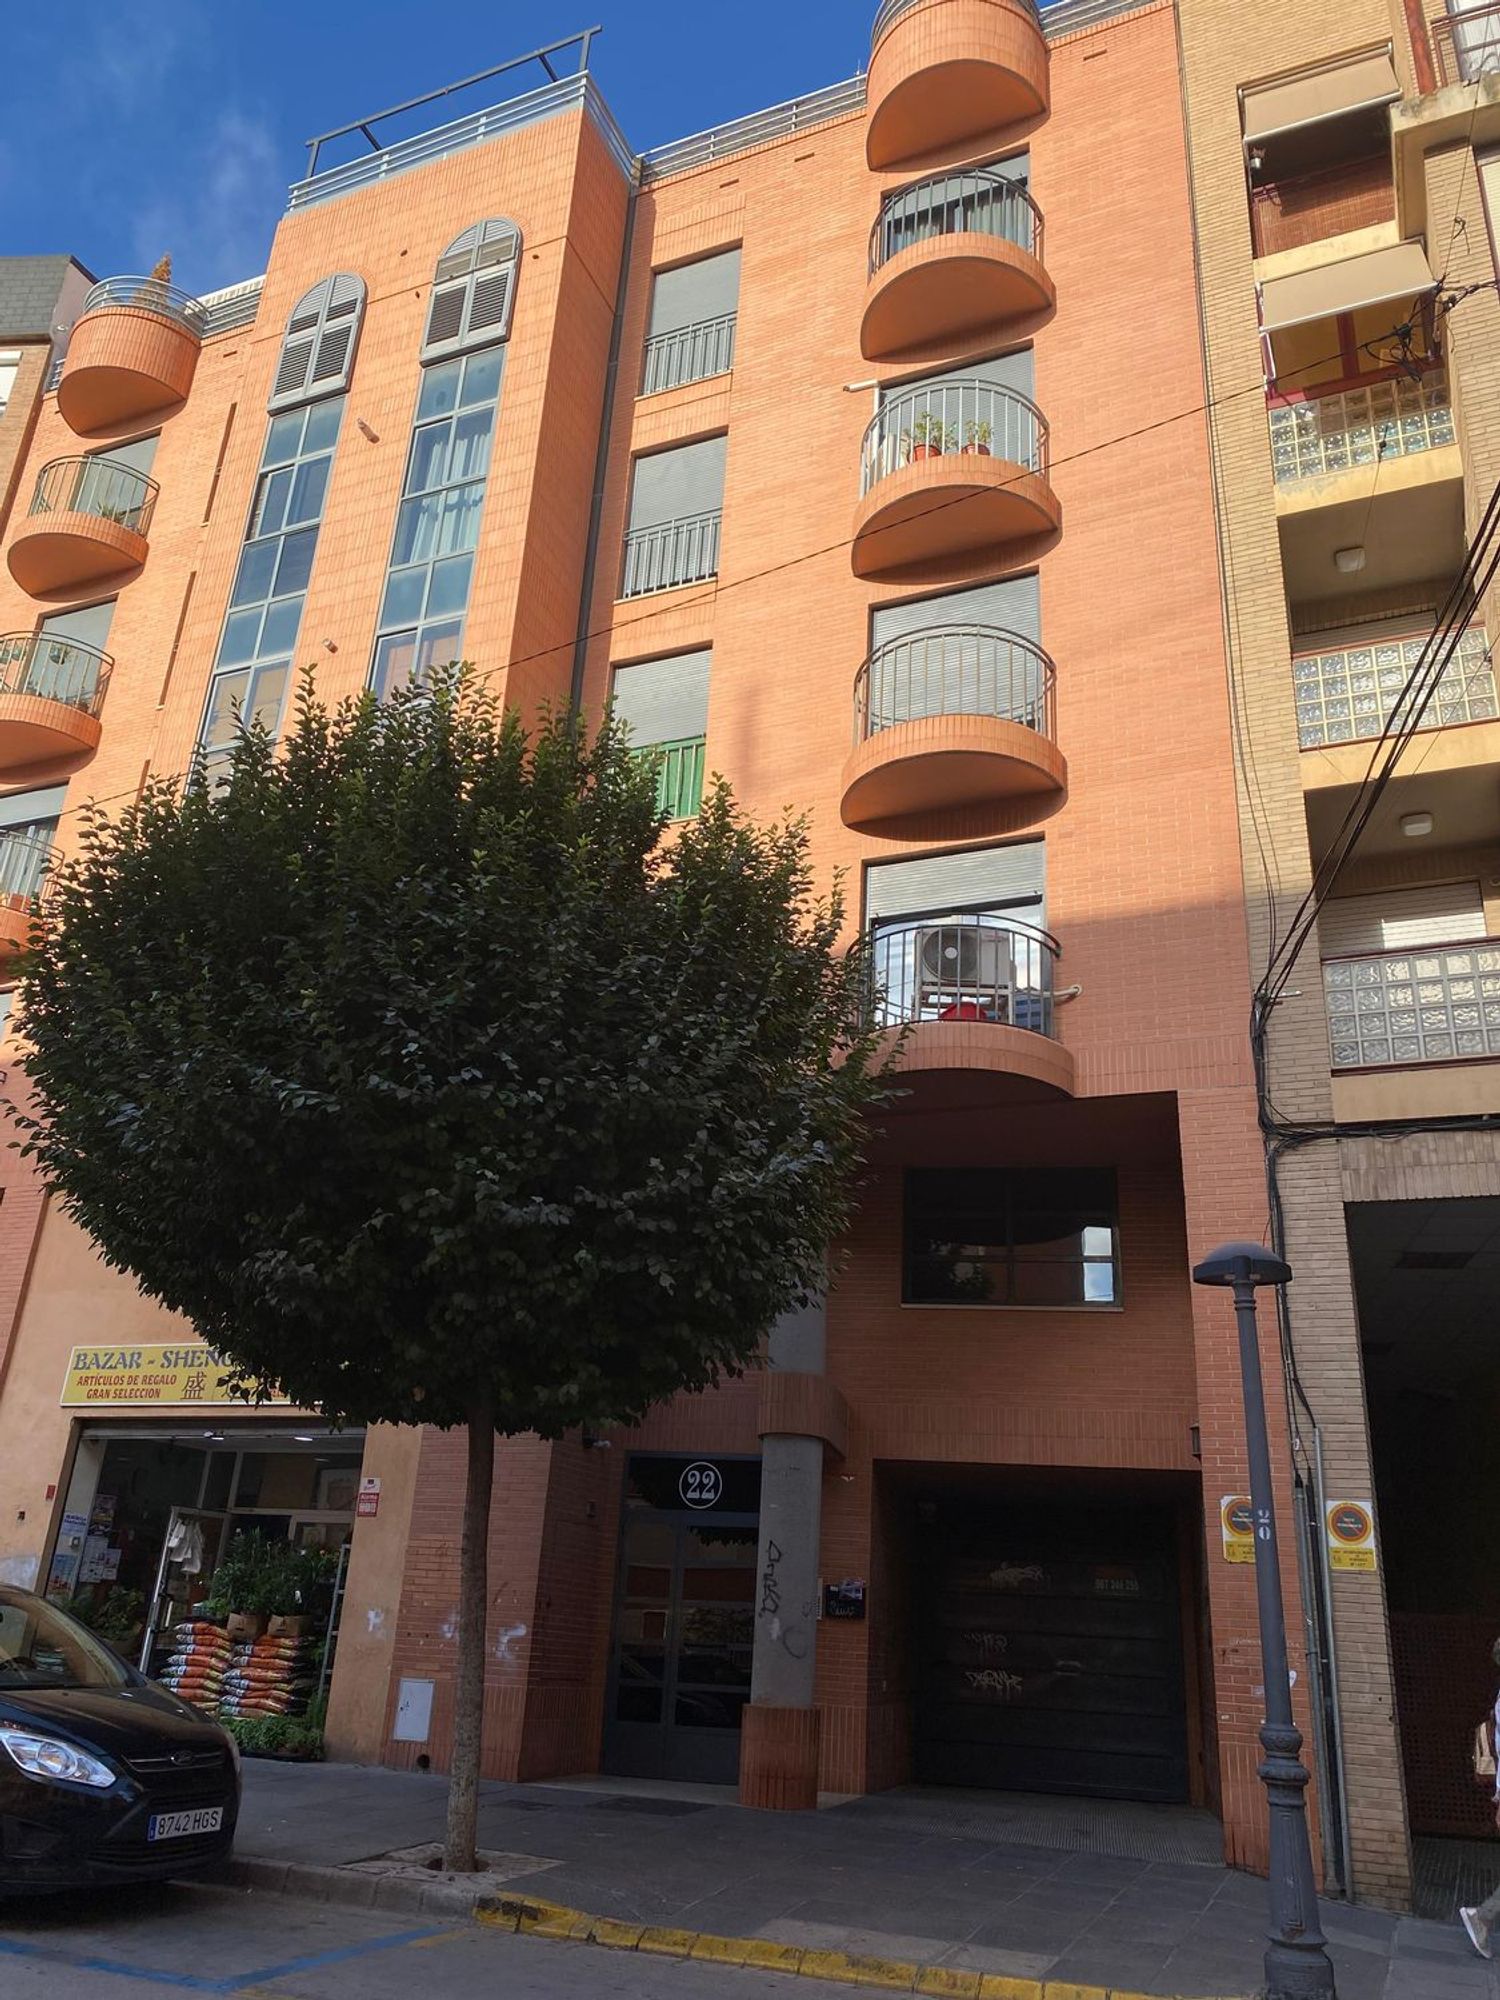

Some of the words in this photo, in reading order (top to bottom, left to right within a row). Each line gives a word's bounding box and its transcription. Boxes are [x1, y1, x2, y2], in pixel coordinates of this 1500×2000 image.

[73, 1351, 142, 1371] BAZAR
[126, 1374, 138, 1385] DE
[141, 1374, 177, 1385] REGALO
[86, 1388, 110, 1399] GRAN
[112, 1388, 161, 1399] SELECCION
[686, 1470, 715, 1499] 22
[158, 1814, 191, 1836] 8742
[193, 1810, 219, 1830] HGS
